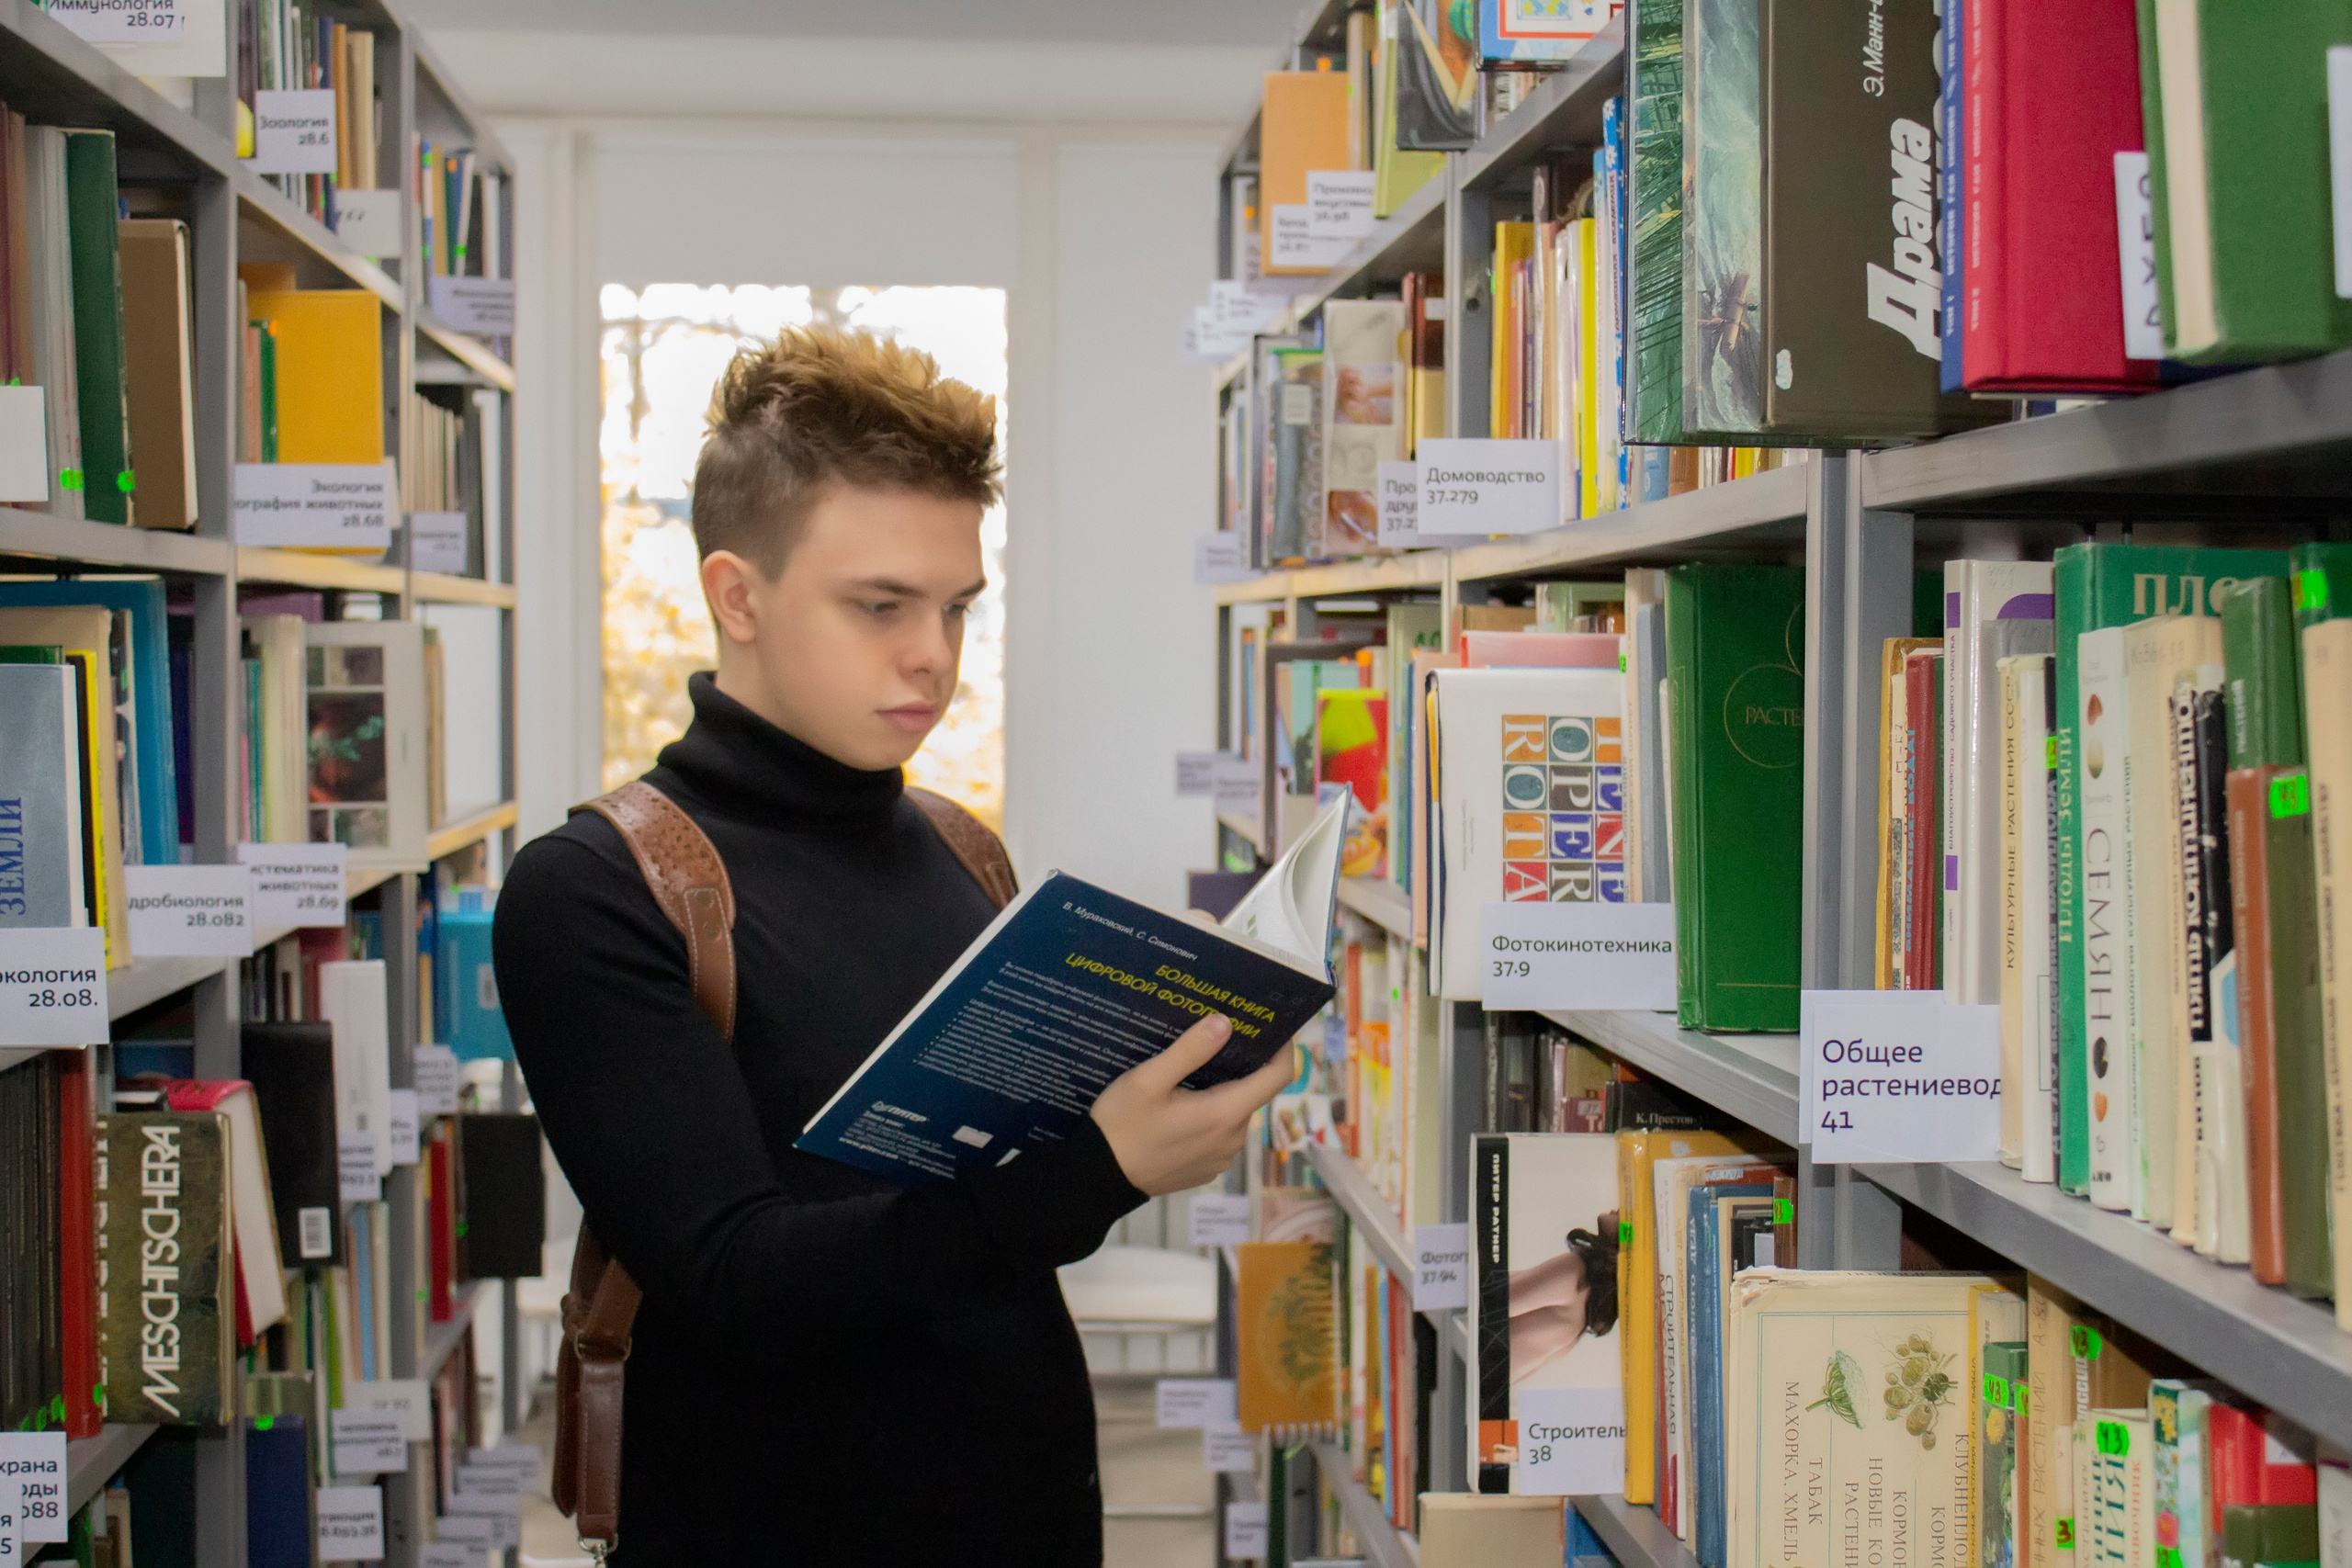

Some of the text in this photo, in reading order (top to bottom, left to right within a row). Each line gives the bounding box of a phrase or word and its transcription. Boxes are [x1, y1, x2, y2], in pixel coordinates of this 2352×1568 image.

[127, 12, 175, 28] 28.07
[260, 116, 329, 130] Зоология
[299, 132, 330, 146] 28.6
[1608, 173, 1617, 245] АКАДЕМИЯ
[1866, 118, 1942, 362] Драма
[312, 479, 383, 493] Экология
[1427, 468, 1546, 484] Домоводство
[306, 499, 383, 510] животных
[1427, 490, 1479, 504] 37.279
[342, 514, 384, 528] 28.68
[2007, 738, 2016, 836] РАСТЕНИЯ
[2058, 727, 2074, 943] Плоды Земли
[0, 796, 27, 916] ЗЕМЛИ
[258, 880, 339, 892] животных
[1906, 811, 1915, 952] ВНИМАНИЕ:
[129, 892, 243, 909] дробиология
[296, 894, 339, 909] 28.69
[2007, 844, 2016, 969] КУЛЬТУРНЫЕ
[187, 911, 245, 928] 28.082
[1062, 901, 1199, 961] В. Мураховский, С. Симонович
[2086, 829, 2111, 1021] СЕМЯН
[1492, 935, 1672, 953] Фотокинотехника
[0, 968, 96, 984] кология
[1493, 961, 1531, 977] 37.9
[28, 988, 98, 1008] 28.08.
[1065, 953, 1261, 1039] ЦИФРОВОЙ ФОТОГФИИ
[1155, 964, 1276, 1024] БОЛЬШАЯ КНИГА
[1822, 1038, 1923, 1067] Общее
[1823, 1078, 2001, 1101] растениевод
[1821, 1111, 1853, 1133] 41
[1492, 1154, 1500, 1263] ПИТЕР РАТНЕР
[141, 1125, 181, 1418] MESCHTSCHERA
[1665, 1274, 1676, 1435] СТРОИТЕЛЬНАЯ
[1529, 1423, 1627, 1442] Строитель
[2031, 1371, 2047, 1495] РАСТЕНИЙ
[2099, 1423, 2122, 1455] 43
[1529, 1445, 1552, 1465] 38
[1807, 1457, 1823, 1525] ТАБАК
[1868, 1457, 1883, 1529] НОВЫЕ
[1953, 1432, 1970, 1568] КЛУБНЕПЛОД
[1782, 1491, 1798, 1562] ХМЕЛЬ
